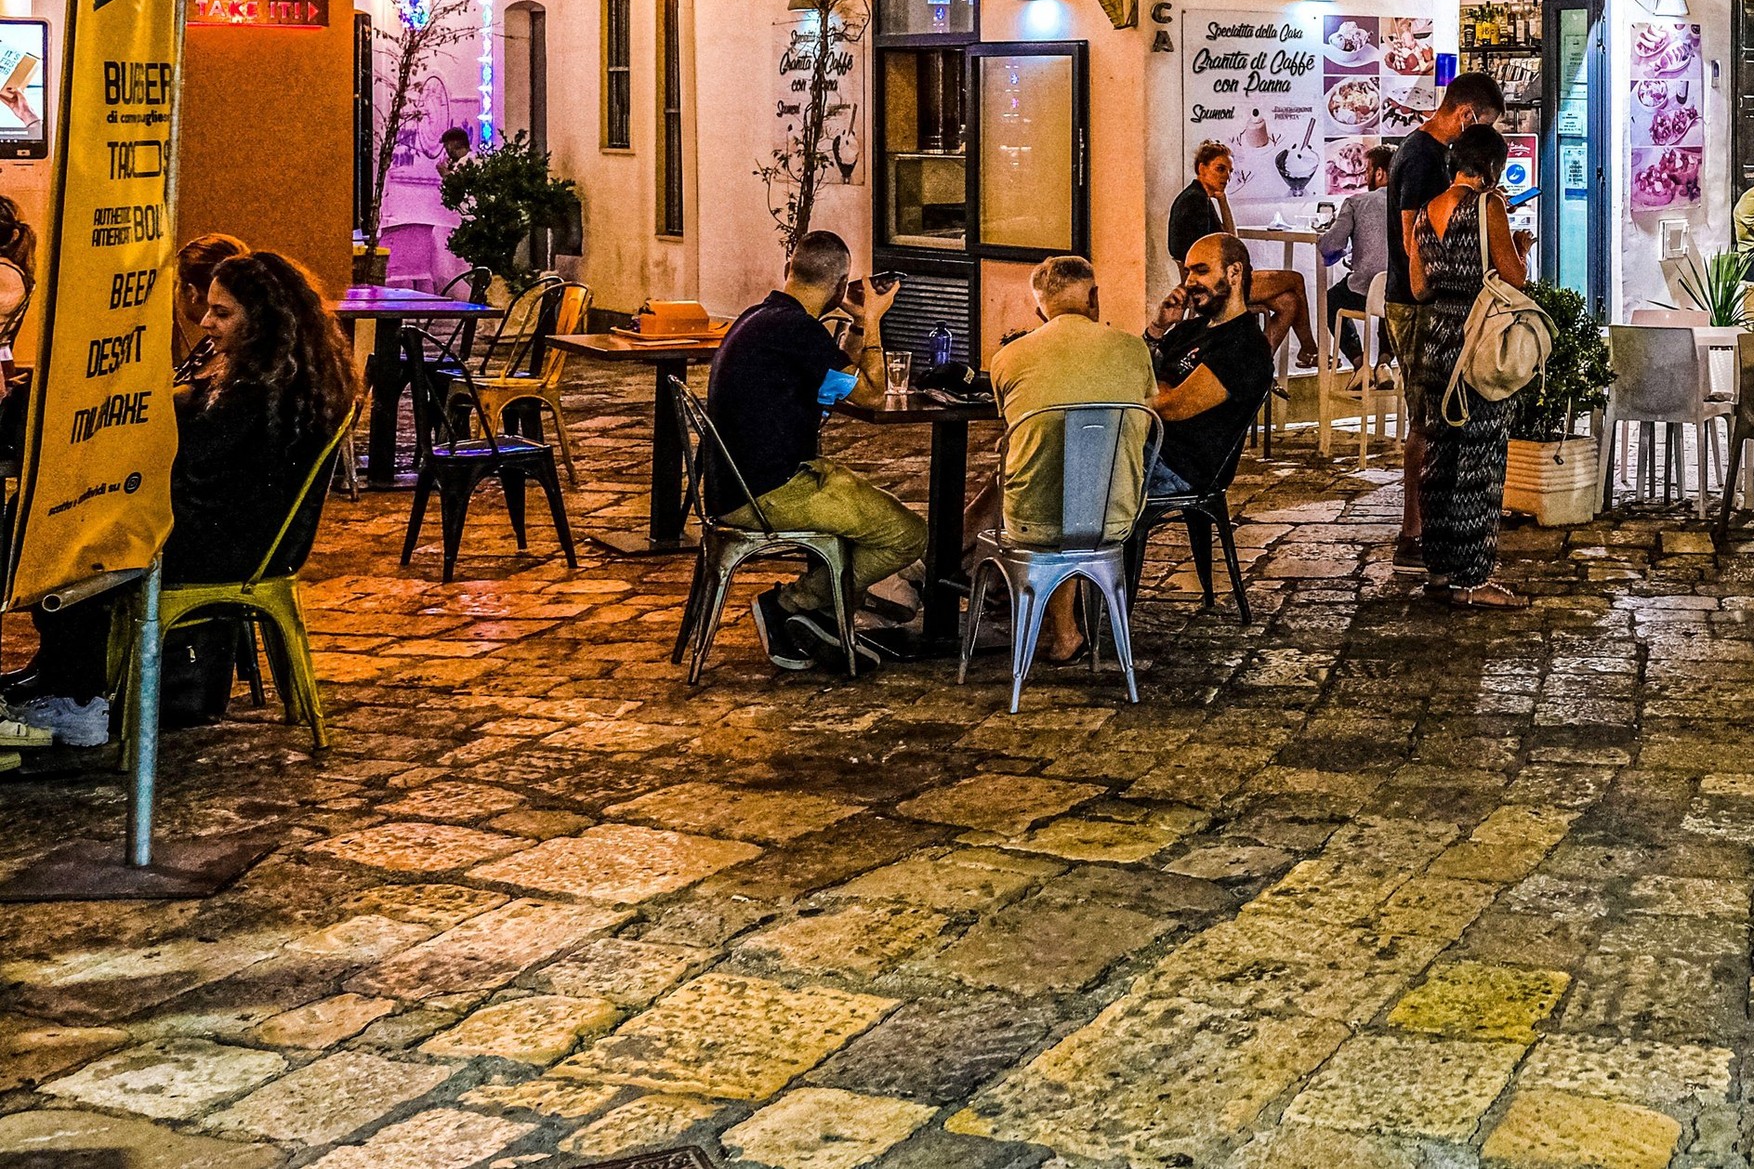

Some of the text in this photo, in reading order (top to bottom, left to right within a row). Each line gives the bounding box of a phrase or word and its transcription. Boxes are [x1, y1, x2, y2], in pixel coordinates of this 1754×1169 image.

[194, 0, 301, 20] TAKE IT!
[1254, 23, 1278, 39] della
[1192, 47, 1250, 74] Granita
[1250, 51, 1268, 70] di
[791, 79, 807, 92] con
[1213, 71, 1292, 98] con Panna
[106, 110, 118, 124] di
[109, 268, 158, 310] BEER
